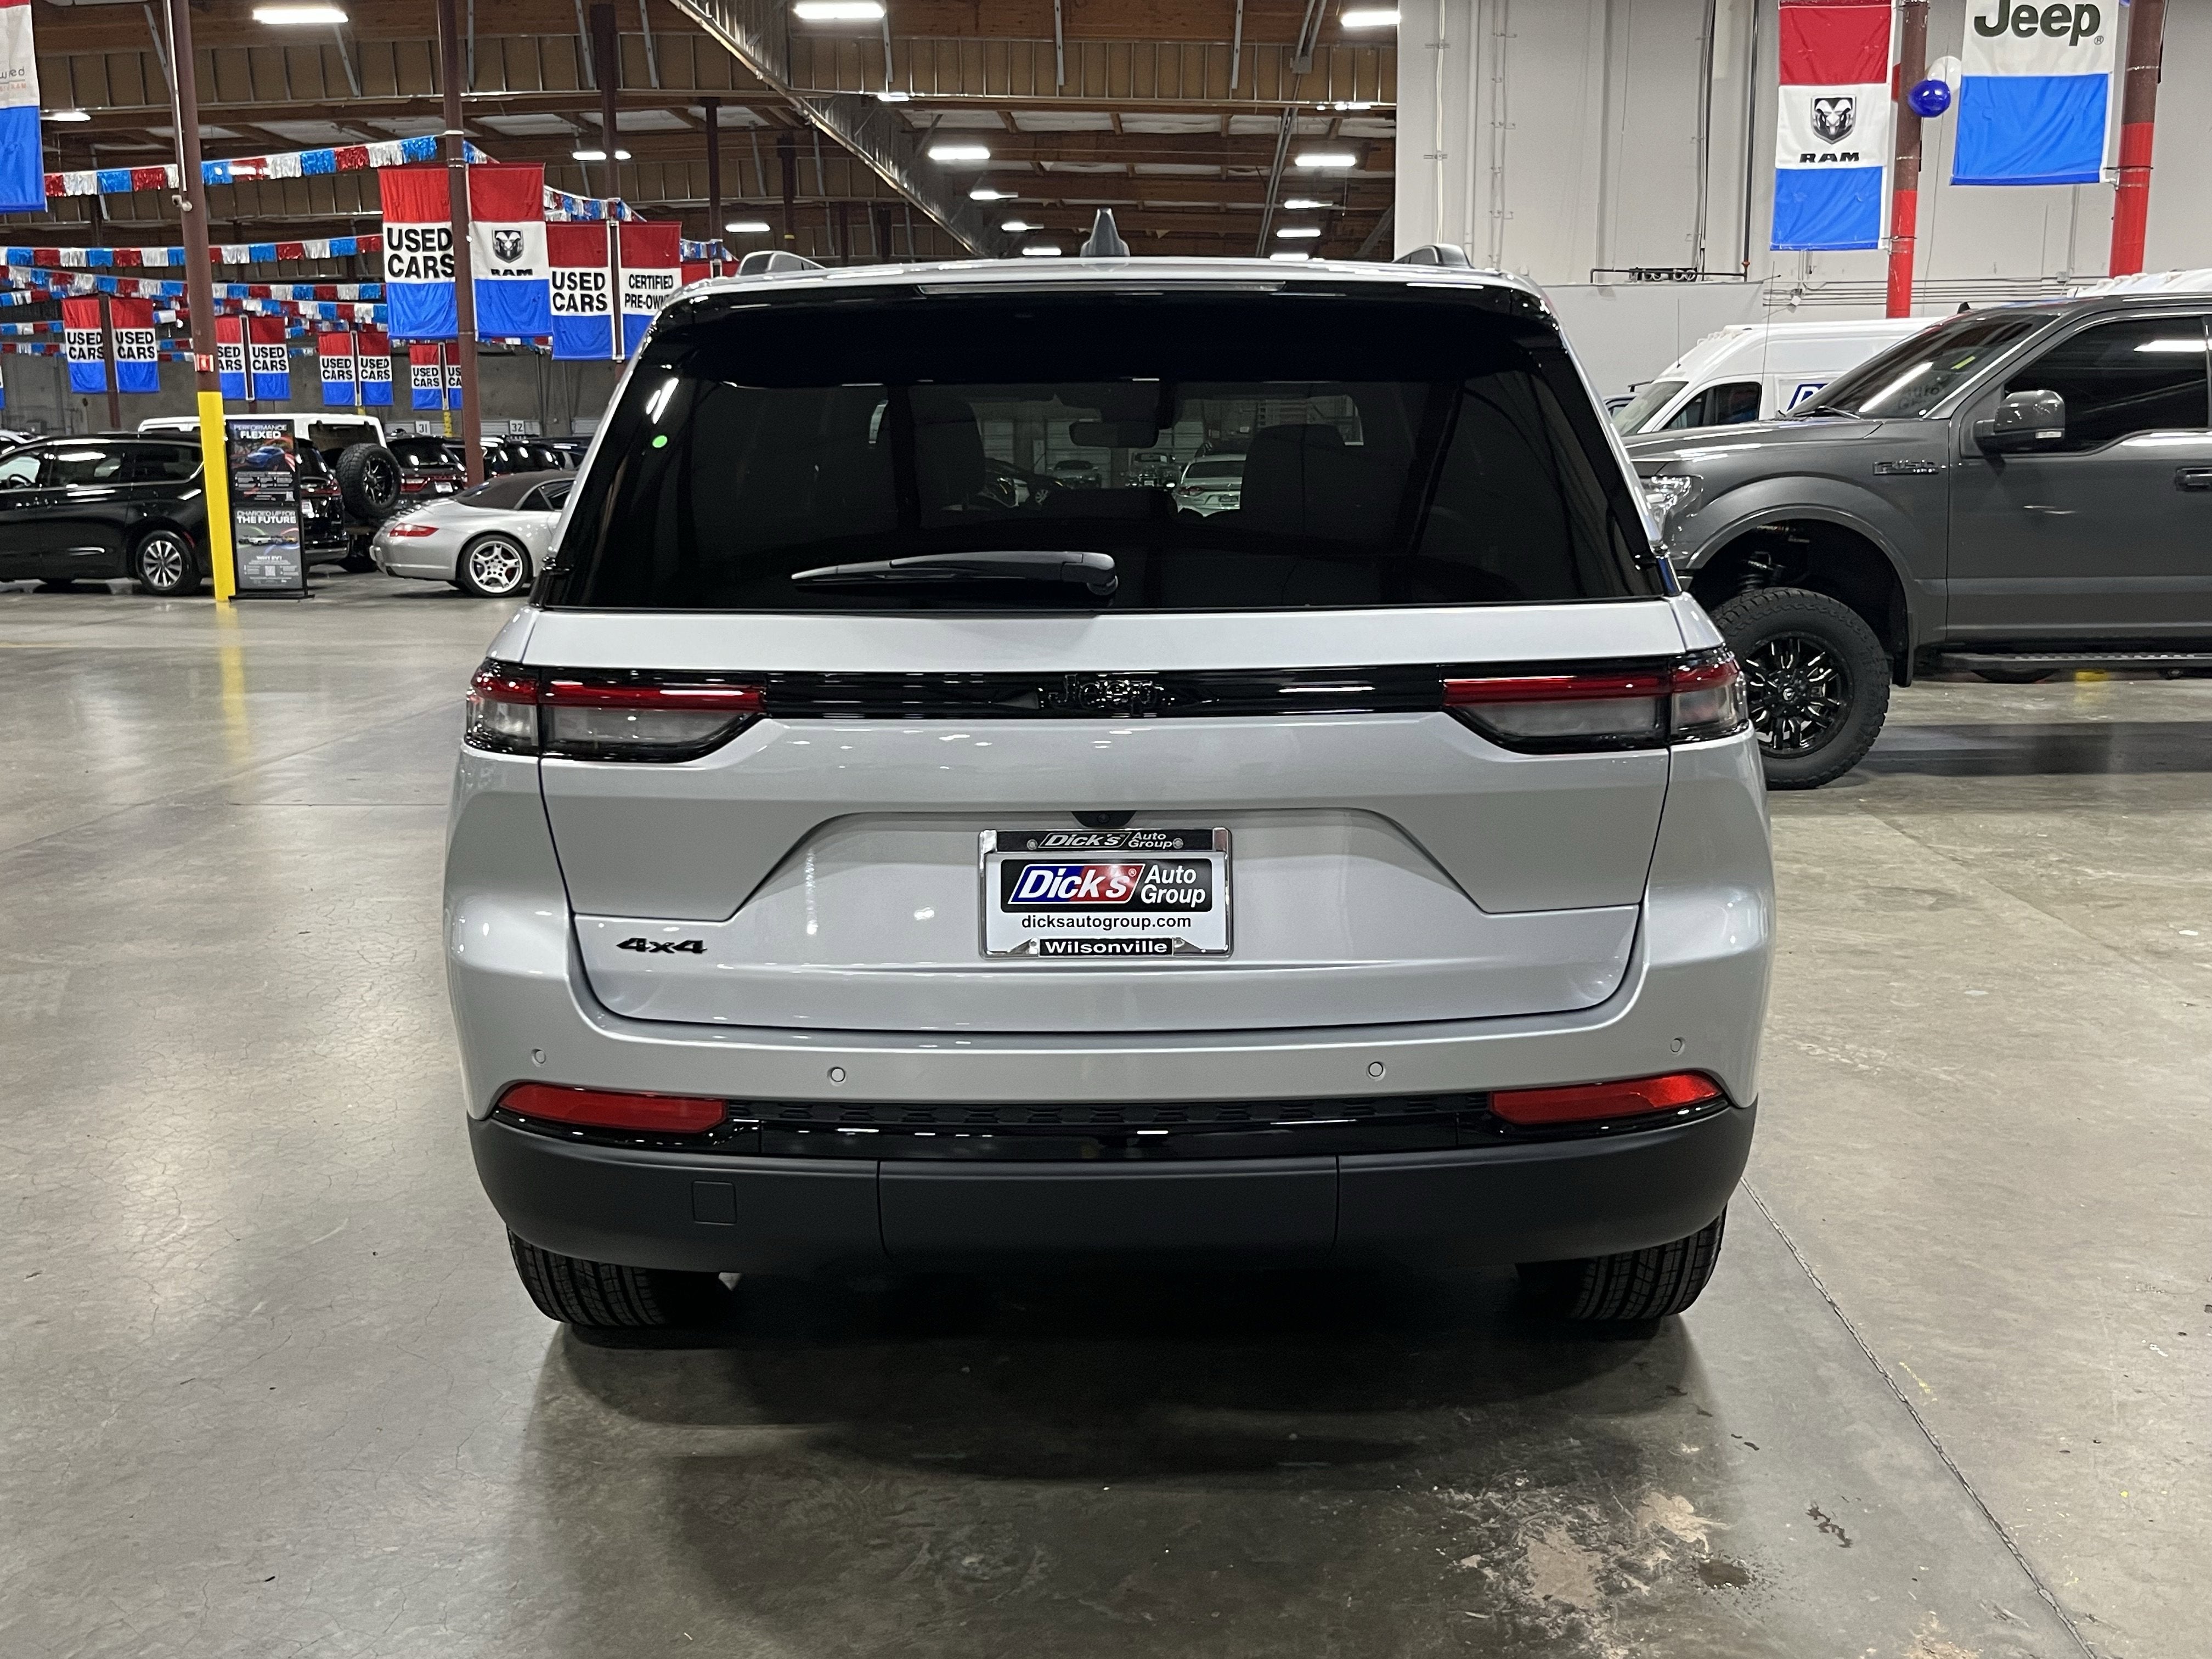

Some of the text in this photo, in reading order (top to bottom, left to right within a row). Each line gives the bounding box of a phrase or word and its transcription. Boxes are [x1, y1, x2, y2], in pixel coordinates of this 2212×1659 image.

[1974, 0, 2101, 46] Jeep
[1799, 153, 1859, 163] RAM
[387, 228, 453, 252] USED
[388, 253, 455, 279] CARS
[552, 271, 606, 291] USED
[628, 274, 673, 289] CERTIFIED
[552, 292, 607, 312] CARS
[67, 331, 103, 345] USED
[116, 331, 154, 345] USED
[69, 346, 104, 359] CARS
[117, 346, 155, 359] CARS
[217, 346, 240, 358] SED
[252, 347, 285, 358] USED
[219, 359, 242, 370] ARS
[252, 359, 287, 371] CARS
[322, 358, 352, 368] USED
[360, 358, 390, 369] USED
[323, 370, 353, 380] CARS
[360, 370, 390, 380] CARS
[413, 368, 438, 376] USED
[448, 368, 461, 376] US
[414, 377, 439, 387] CARS
[448, 377, 462, 386] CA
[419, 424, 427, 433] 31
[511, 423, 523, 432] 32
[240, 431, 281, 439] FLEXED
[1045, 832, 1166, 846] Dick's Auto
[1128, 839, 1172, 849] Group
[1019, 865, 1197, 899] Dick's Auto
[1141, 885, 1206, 907] Group
[1022, 915, 1192, 931] dicksautogroup.com
[616, 938, 708, 953] 4x4
[1045, 941, 1167, 953] Wilsonville
